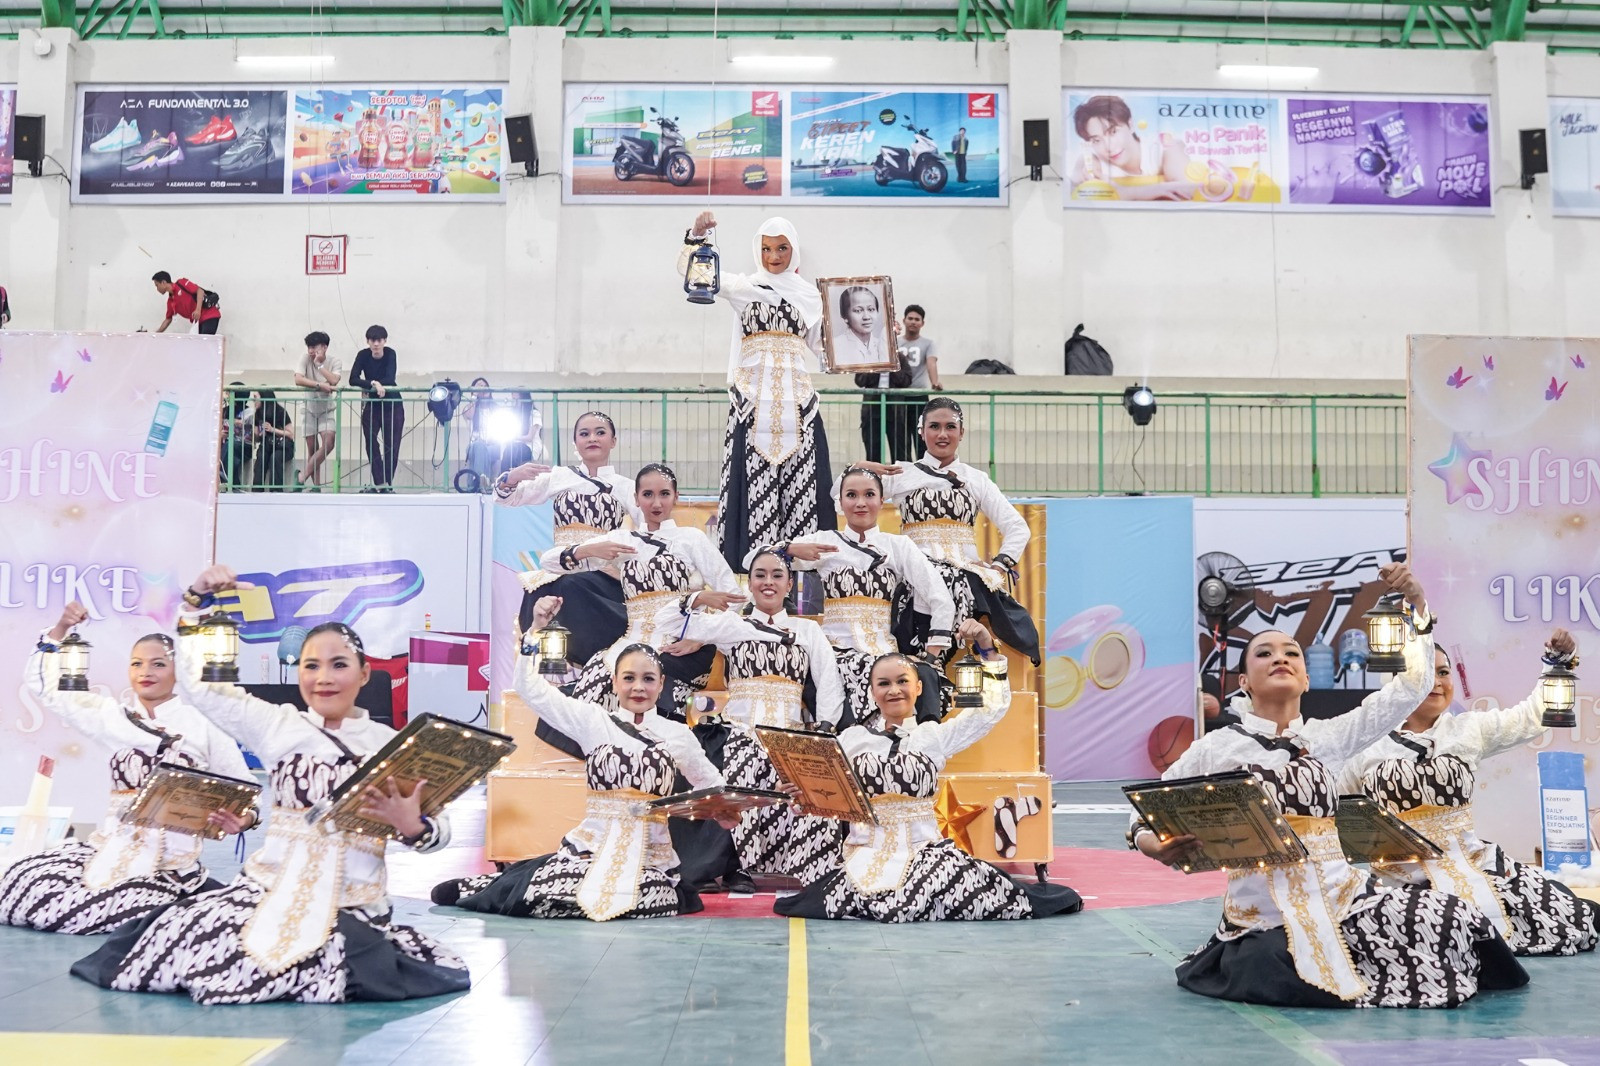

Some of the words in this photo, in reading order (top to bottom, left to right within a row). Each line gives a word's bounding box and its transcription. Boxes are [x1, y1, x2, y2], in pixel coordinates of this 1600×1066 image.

[148, 99, 231, 109] FUNDAMENTAL
[233, 99, 250, 108] 3.0
[370, 95, 408, 104] SEBOTOL
[1158, 103, 1266, 119] azarine
[1291, 109, 1328, 120] BLUEBERRY
[1329, 105, 1350, 114] BLAST
[1294, 115, 1354, 134] SEGERNYA
[1562, 124, 1598, 137] JACKSON
[800, 130, 876, 151] KEREN
[1185, 130, 1210, 143] No
[1214, 124, 1266, 142] Panik
[1296, 126, 1355, 144] NAMPOOOL
[711, 143, 763, 158] BENER
[1185, 145, 1195, 154] di
[1199, 145, 1235, 155] Bawah
[365, 171, 391, 179] SEMUA
[392, 171, 408, 179] AKSI
[409, 171, 440, 180] SERUMU
[1438, 162, 1486, 181] MOVE
[1546, 821, 1586, 829] EXFOLIATING
